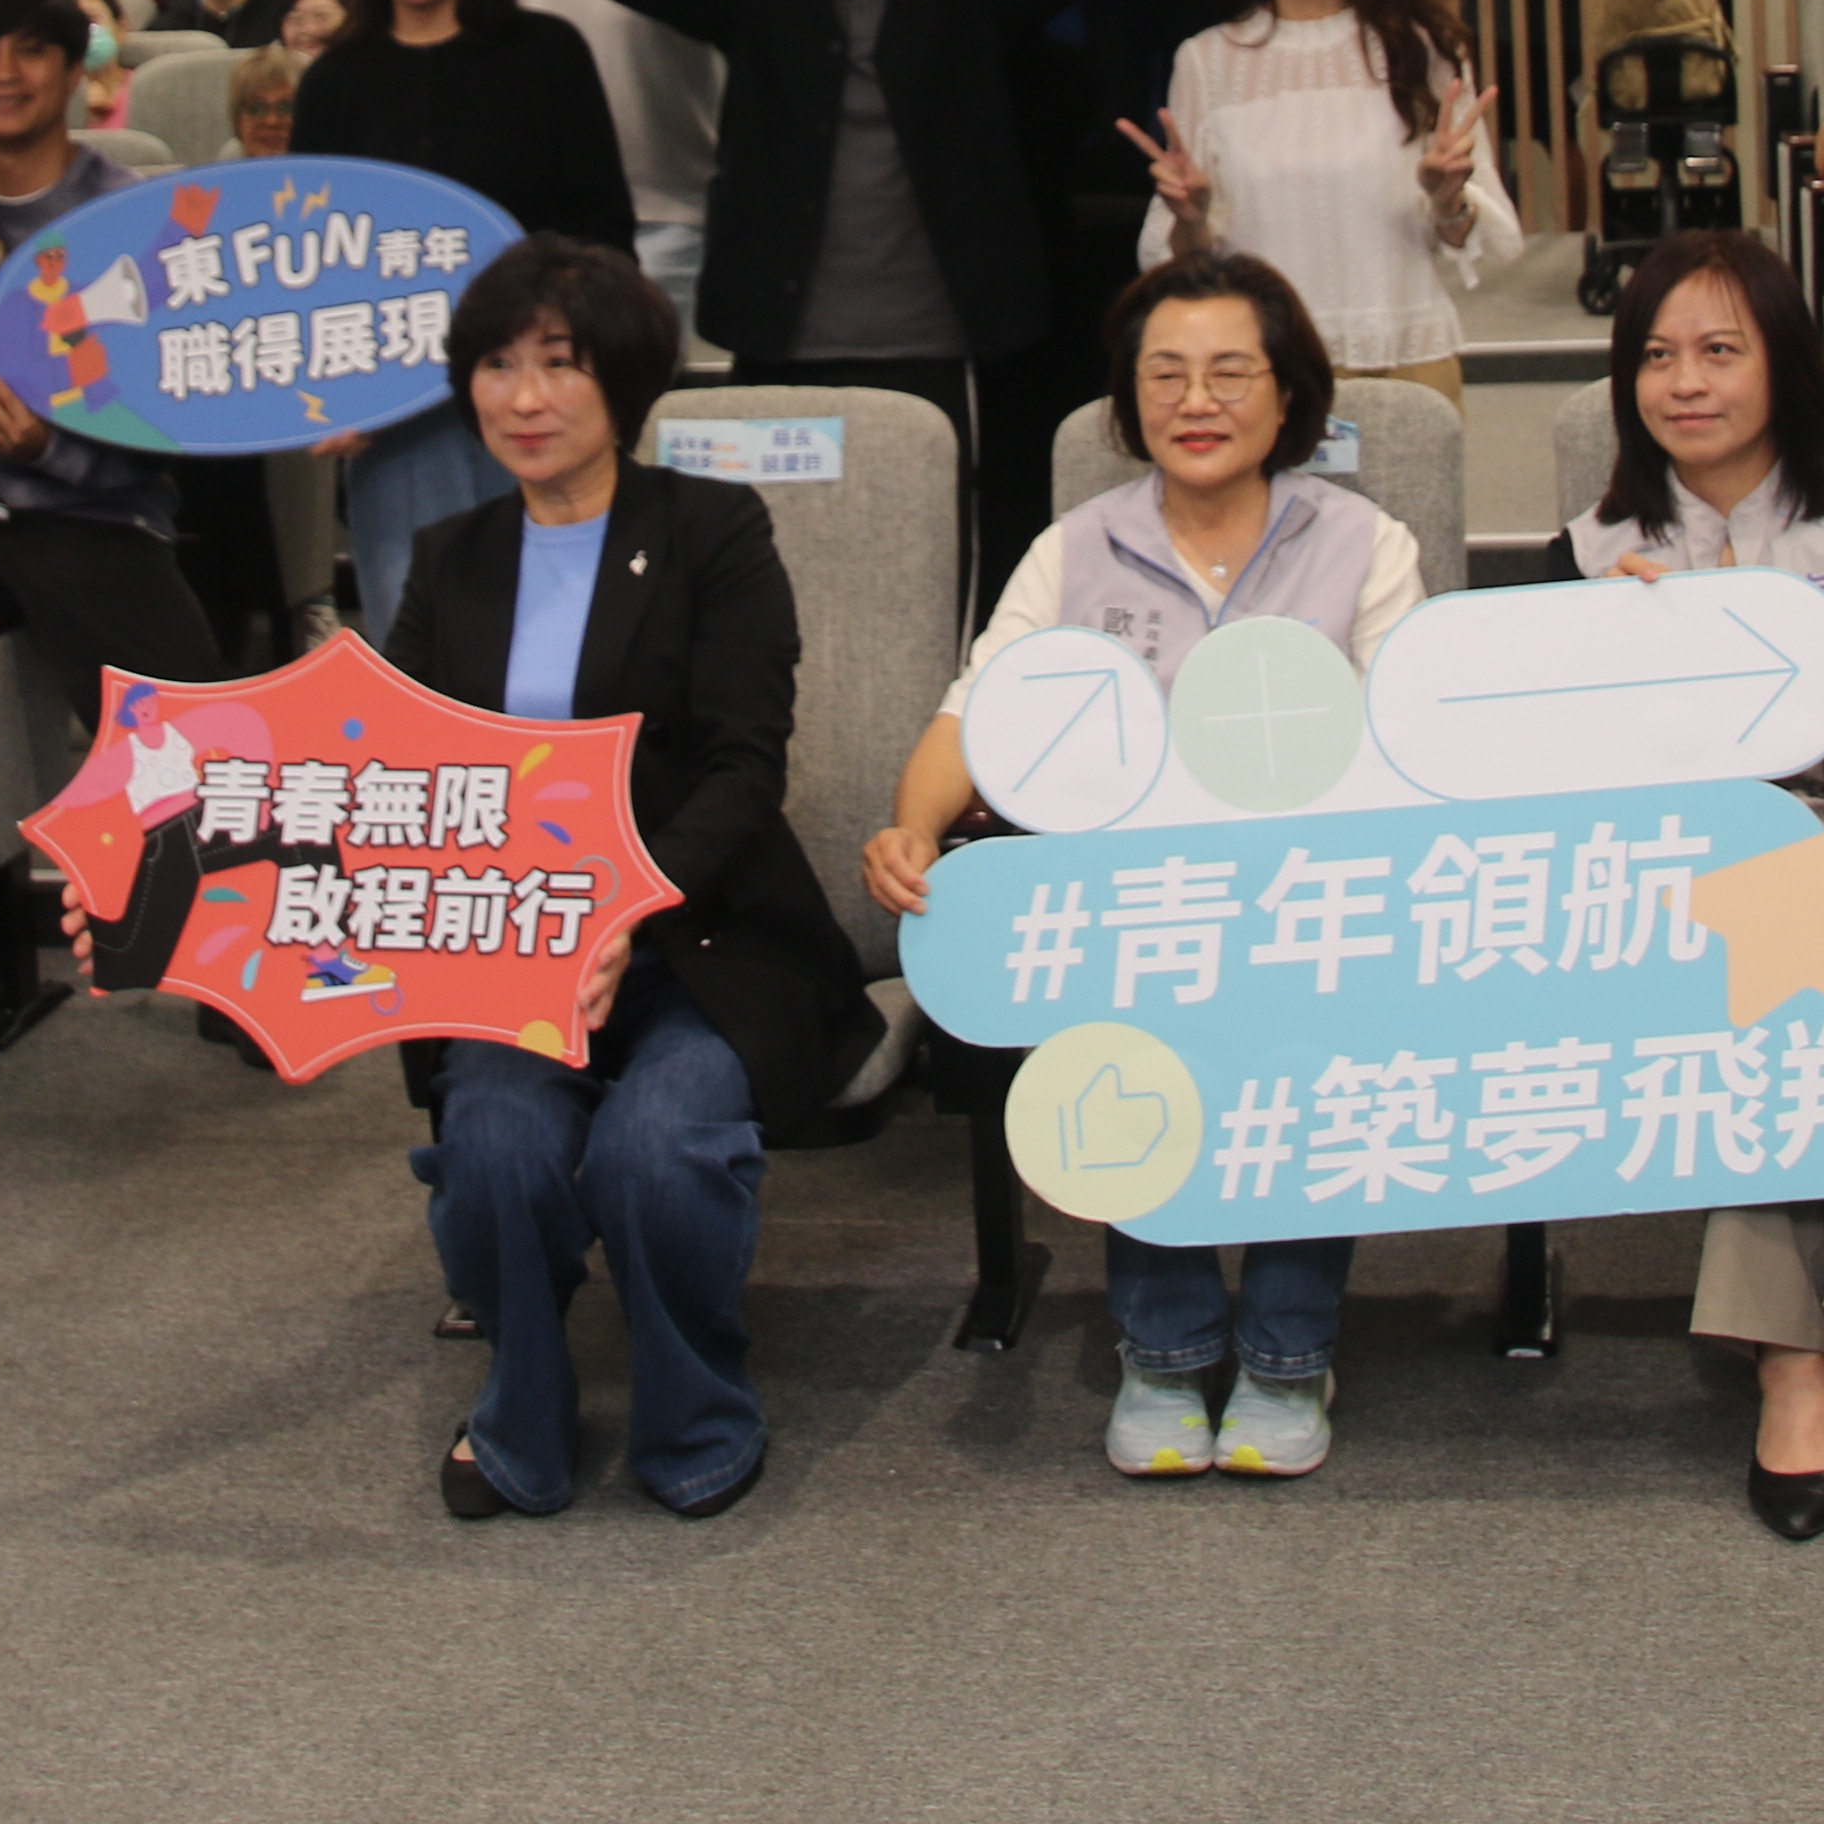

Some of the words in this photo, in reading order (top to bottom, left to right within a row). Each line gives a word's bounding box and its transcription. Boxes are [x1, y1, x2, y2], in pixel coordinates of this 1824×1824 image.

[158, 290, 452, 401] 職得展現
[196, 759, 510, 849] 青春無限
[267, 865, 595, 956] 啟程前行
[1005, 813, 1712, 1009] #青年領航
